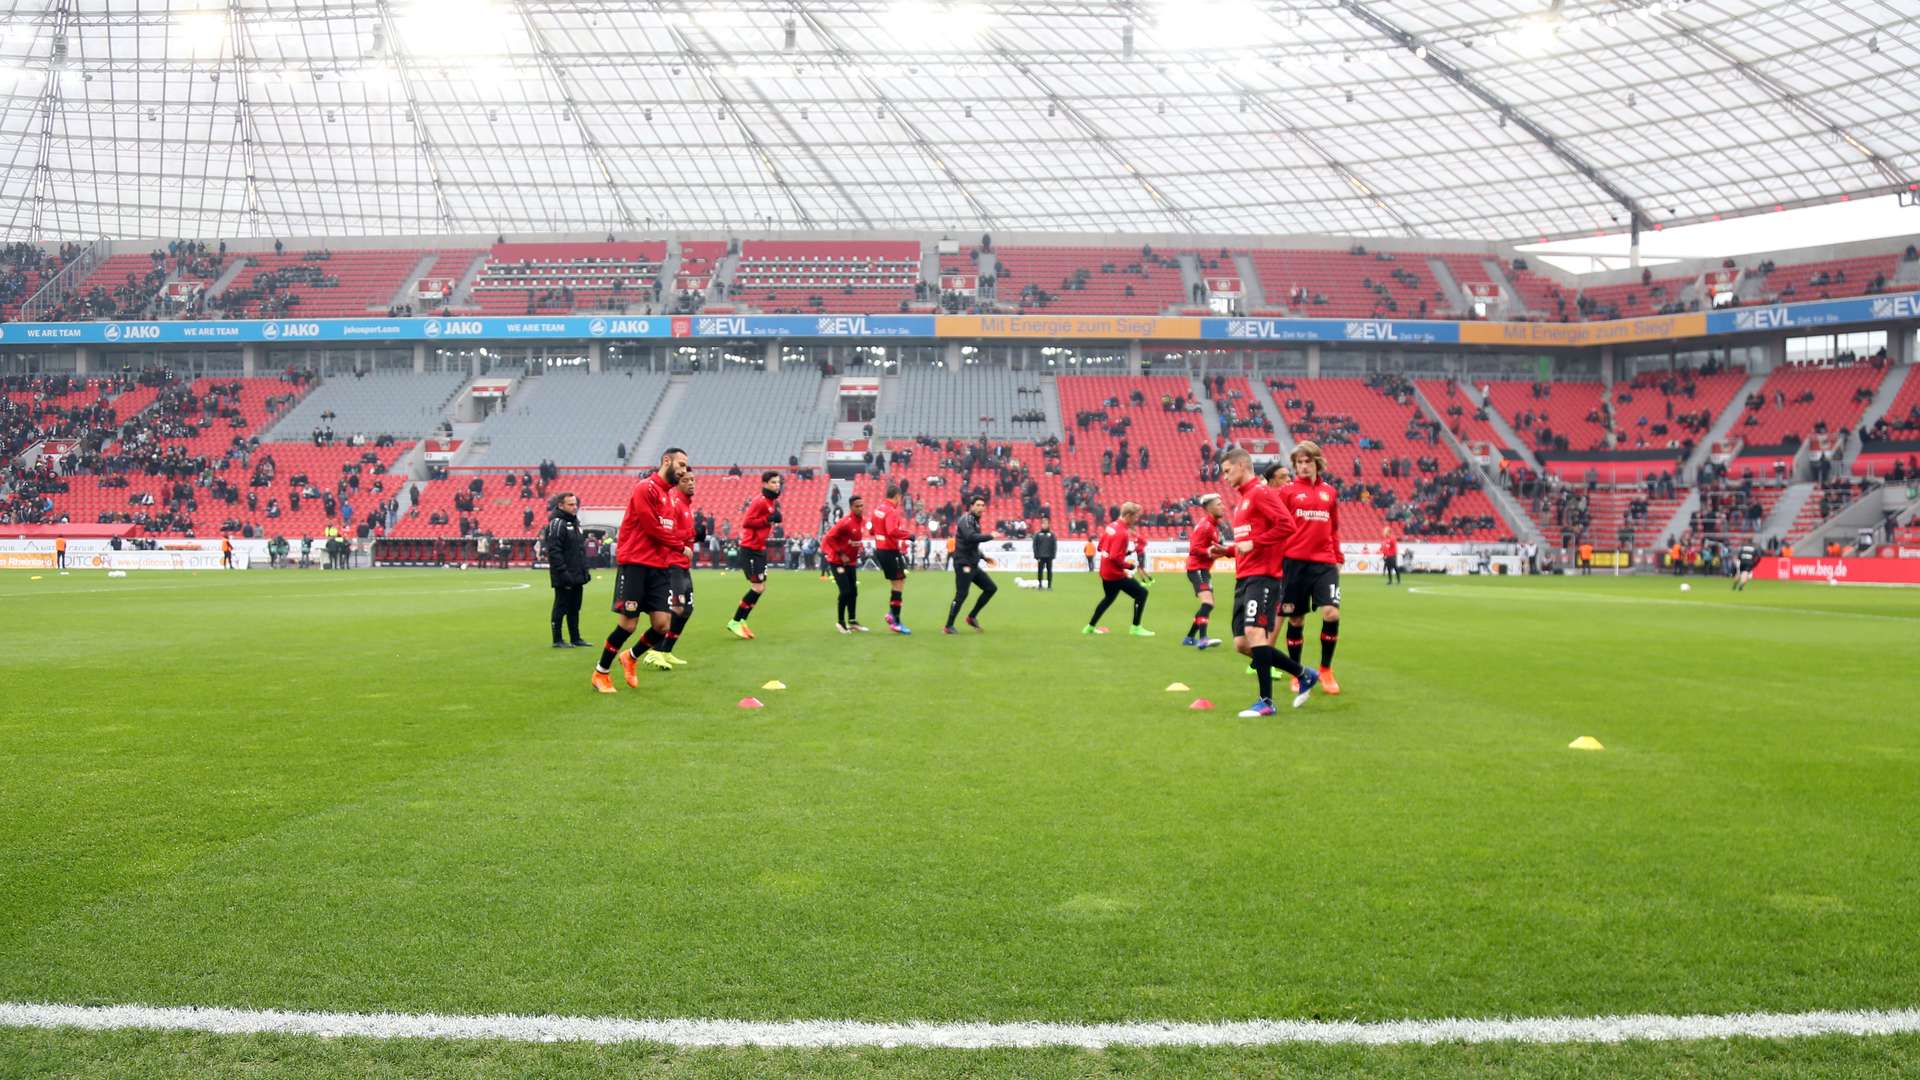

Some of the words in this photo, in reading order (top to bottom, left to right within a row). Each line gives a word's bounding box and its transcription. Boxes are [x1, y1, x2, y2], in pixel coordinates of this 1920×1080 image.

[610, 320, 649, 333] JAKO
[715, 317, 751, 335] EVL
[836, 317, 871, 335] EVL
[1755, 309, 1794, 328] EVL
[27, 329, 40, 337] WE
[42, 329, 58, 337] ARE
[60, 329, 81, 337] TEAM
[123, 326, 160, 339] JAKO
[184, 328, 198, 336] WE
[199, 328, 215, 336] ARE
[216, 327, 239, 336] TEAM
[282, 324, 320, 337] JAKO
[444, 322, 482, 335] JAKO
[507, 324, 521, 332] WE
[522, 324, 539, 332] ARE
[541, 323, 565, 332] TEAM
[980, 318, 1005, 332] Mit
[1010, 318, 1072, 336] Energie
[1077, 321, 1111, 332] zum
[1117, 318, 1156, 336] Sieg!
[1246, 321, 1280, 338] EVL
[1363, 322, 1397, 340] EVL
[1792, 559, 1847, 580] www.beg.de
[1247, 600, 1257, 616] 8
